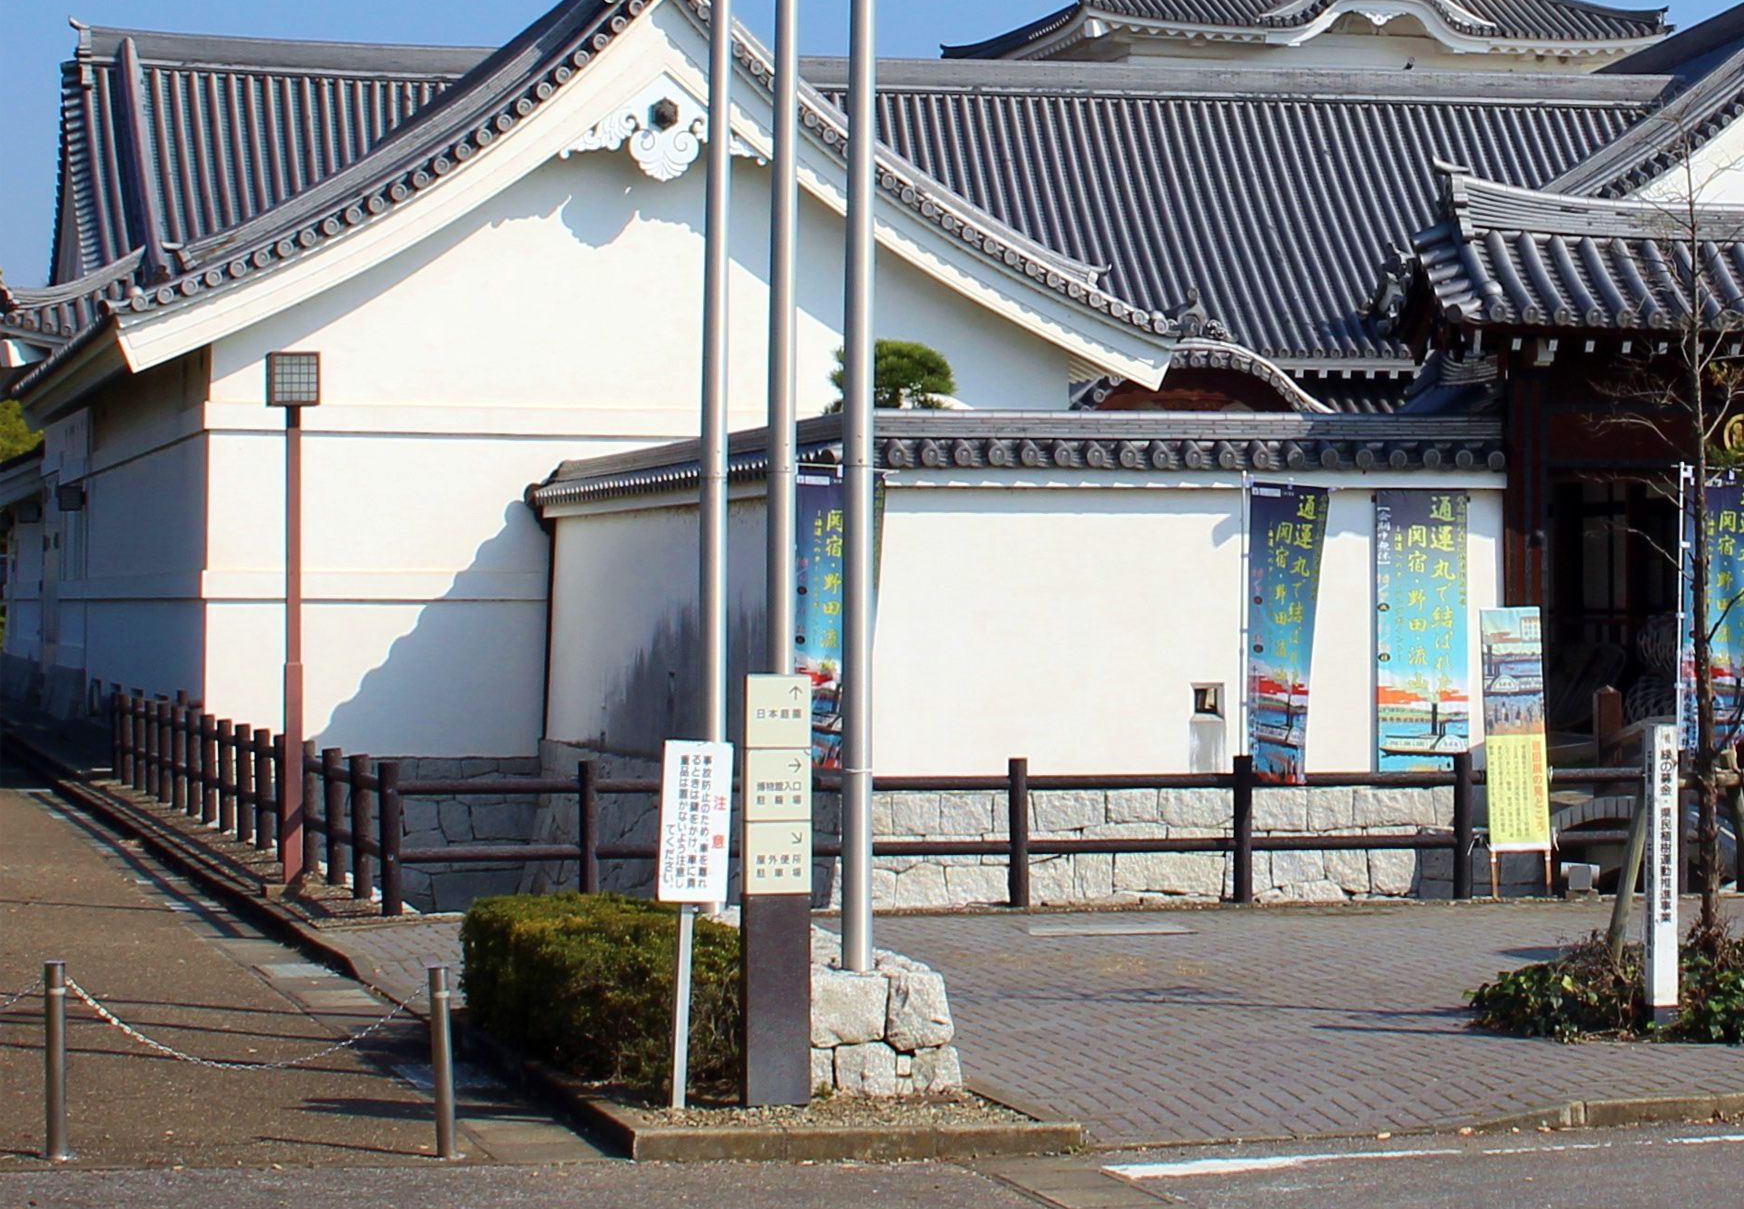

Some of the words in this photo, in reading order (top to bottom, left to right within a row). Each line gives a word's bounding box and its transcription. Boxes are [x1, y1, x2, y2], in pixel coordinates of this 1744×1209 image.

[756, 781, 802, 792] 博物館入口
[756, 855, 802, 865] 屋外便所
